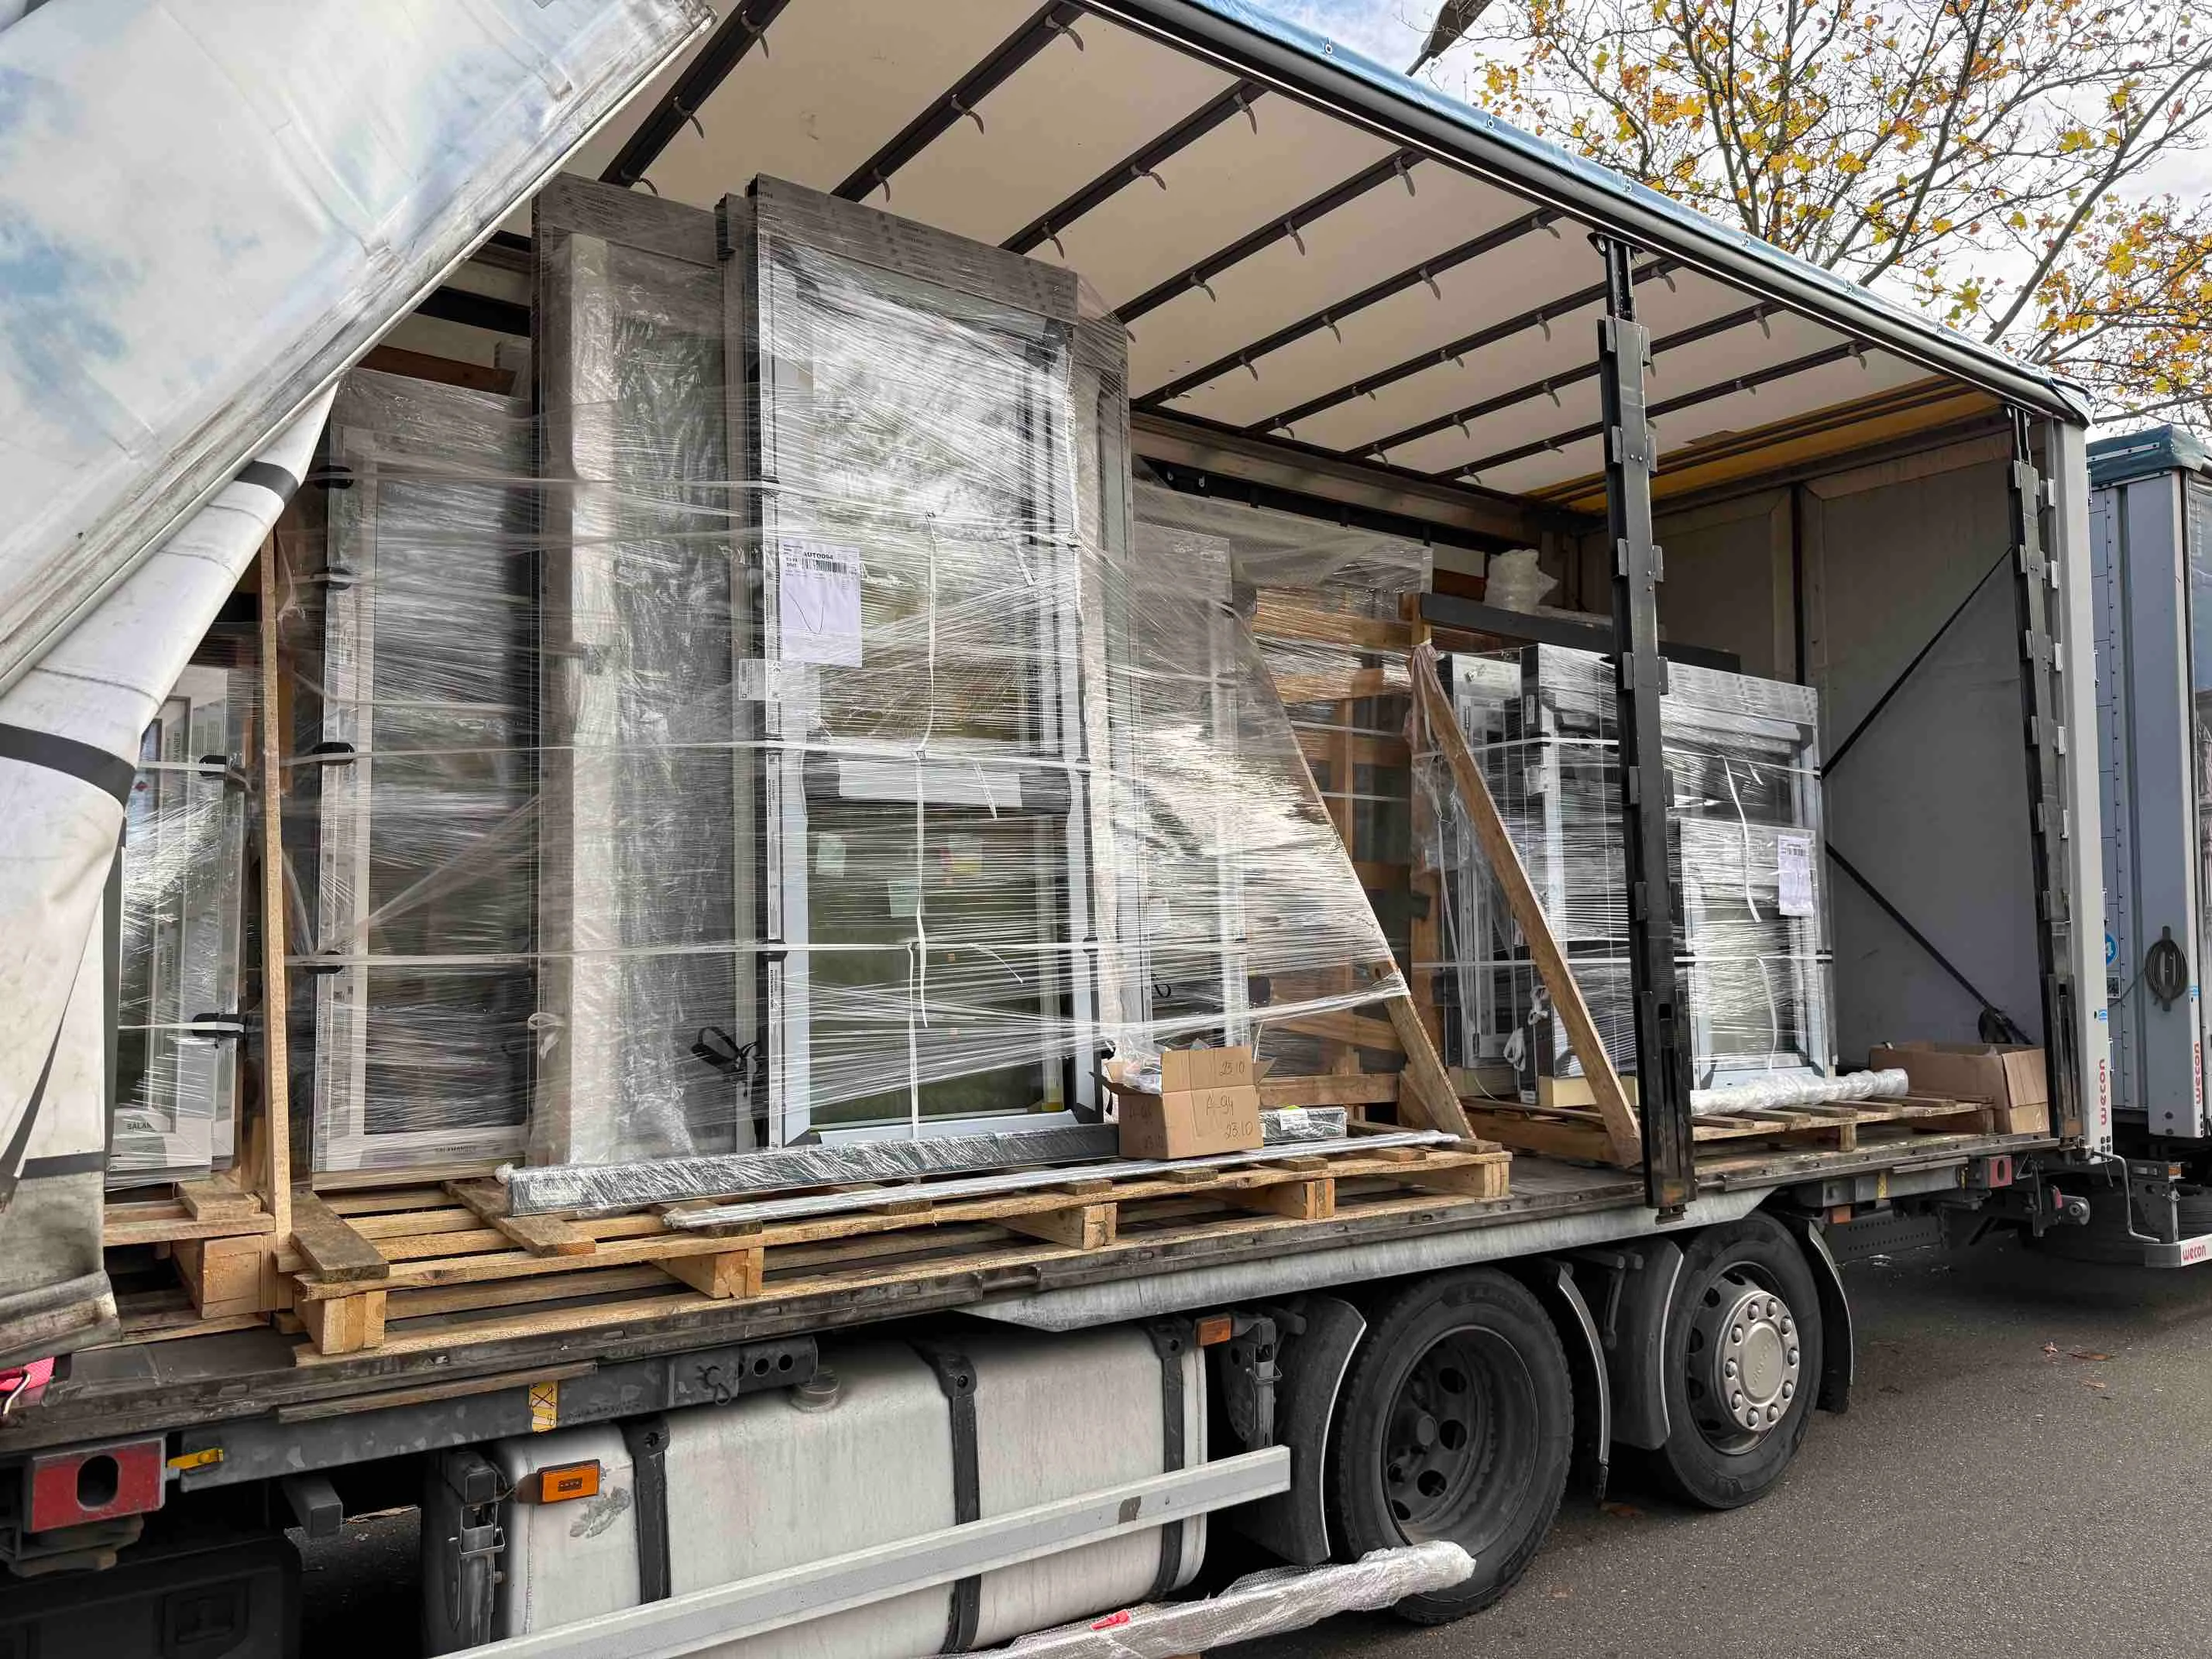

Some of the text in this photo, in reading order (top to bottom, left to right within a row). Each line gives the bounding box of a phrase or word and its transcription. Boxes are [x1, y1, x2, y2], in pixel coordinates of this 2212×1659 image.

[2099, 1059, 2107, 1125] wecon
[2193, 1042, 2202, 1105] wecon
[2183, 1245, 2207, 1261] wecon
